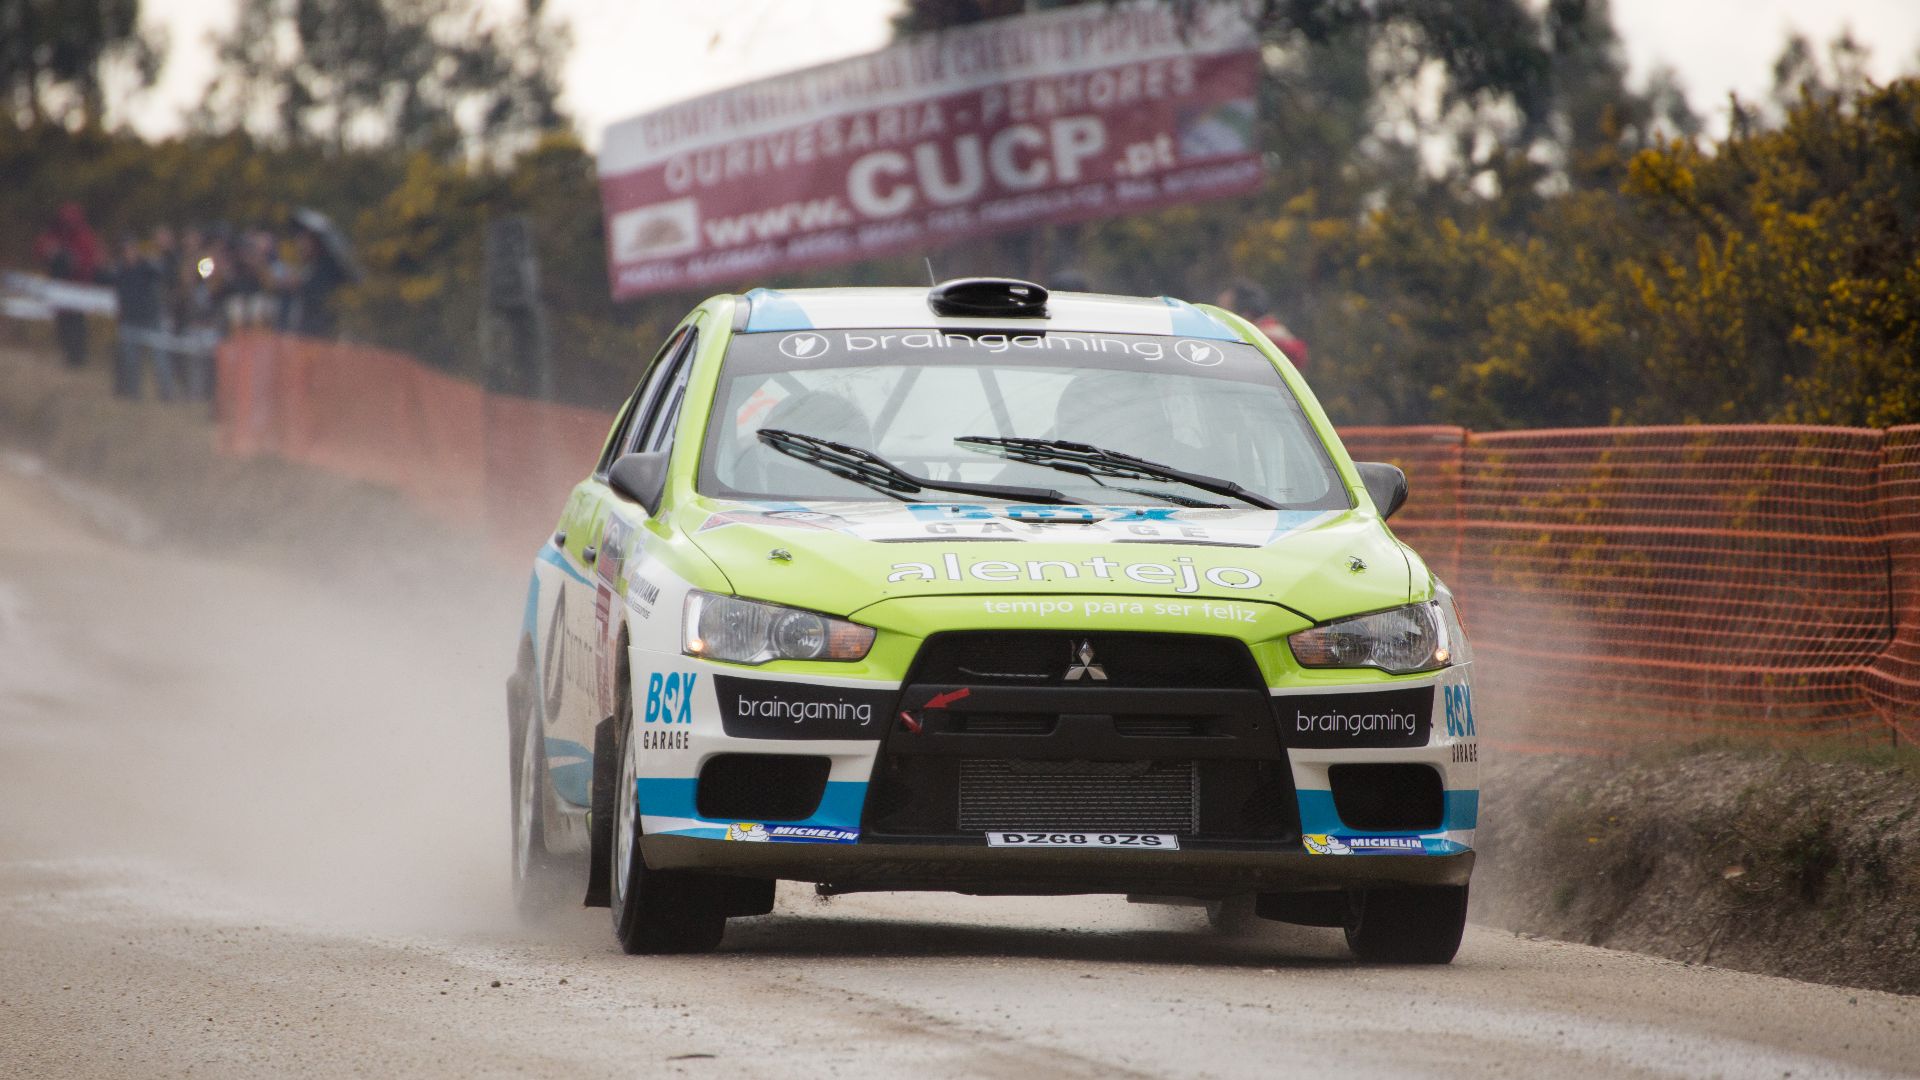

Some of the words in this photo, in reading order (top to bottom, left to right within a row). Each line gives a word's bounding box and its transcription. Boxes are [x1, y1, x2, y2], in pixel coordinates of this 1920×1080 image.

[664, 101, 945, 192] OURIVESARIA
[981, 59, 1194, 125] PENHORES
[845, 331, 1164, 361] braingaming
[887, 552, 1263, 594] alentejo
[984, 598, 1073, 616] tempo
[1085, 601, 1143, 617] para
[1154, 603, 1192, 617] ser
[1201, 602, 1258, 623] feliz
[644, 671, 697, 724] BOX
[738, 694, 872, 725] braingaming
[1443, 684, 1476, 737] BOX
[1296, 708, 1416, 736] braingaming
[643, 730, 690, 750] GARAGE
[1452, 743, 1478, 763] GARAGE
[773, 825, 858, 841] MICHELIN
[1350, 837, 1422, 848] MICHELIN
